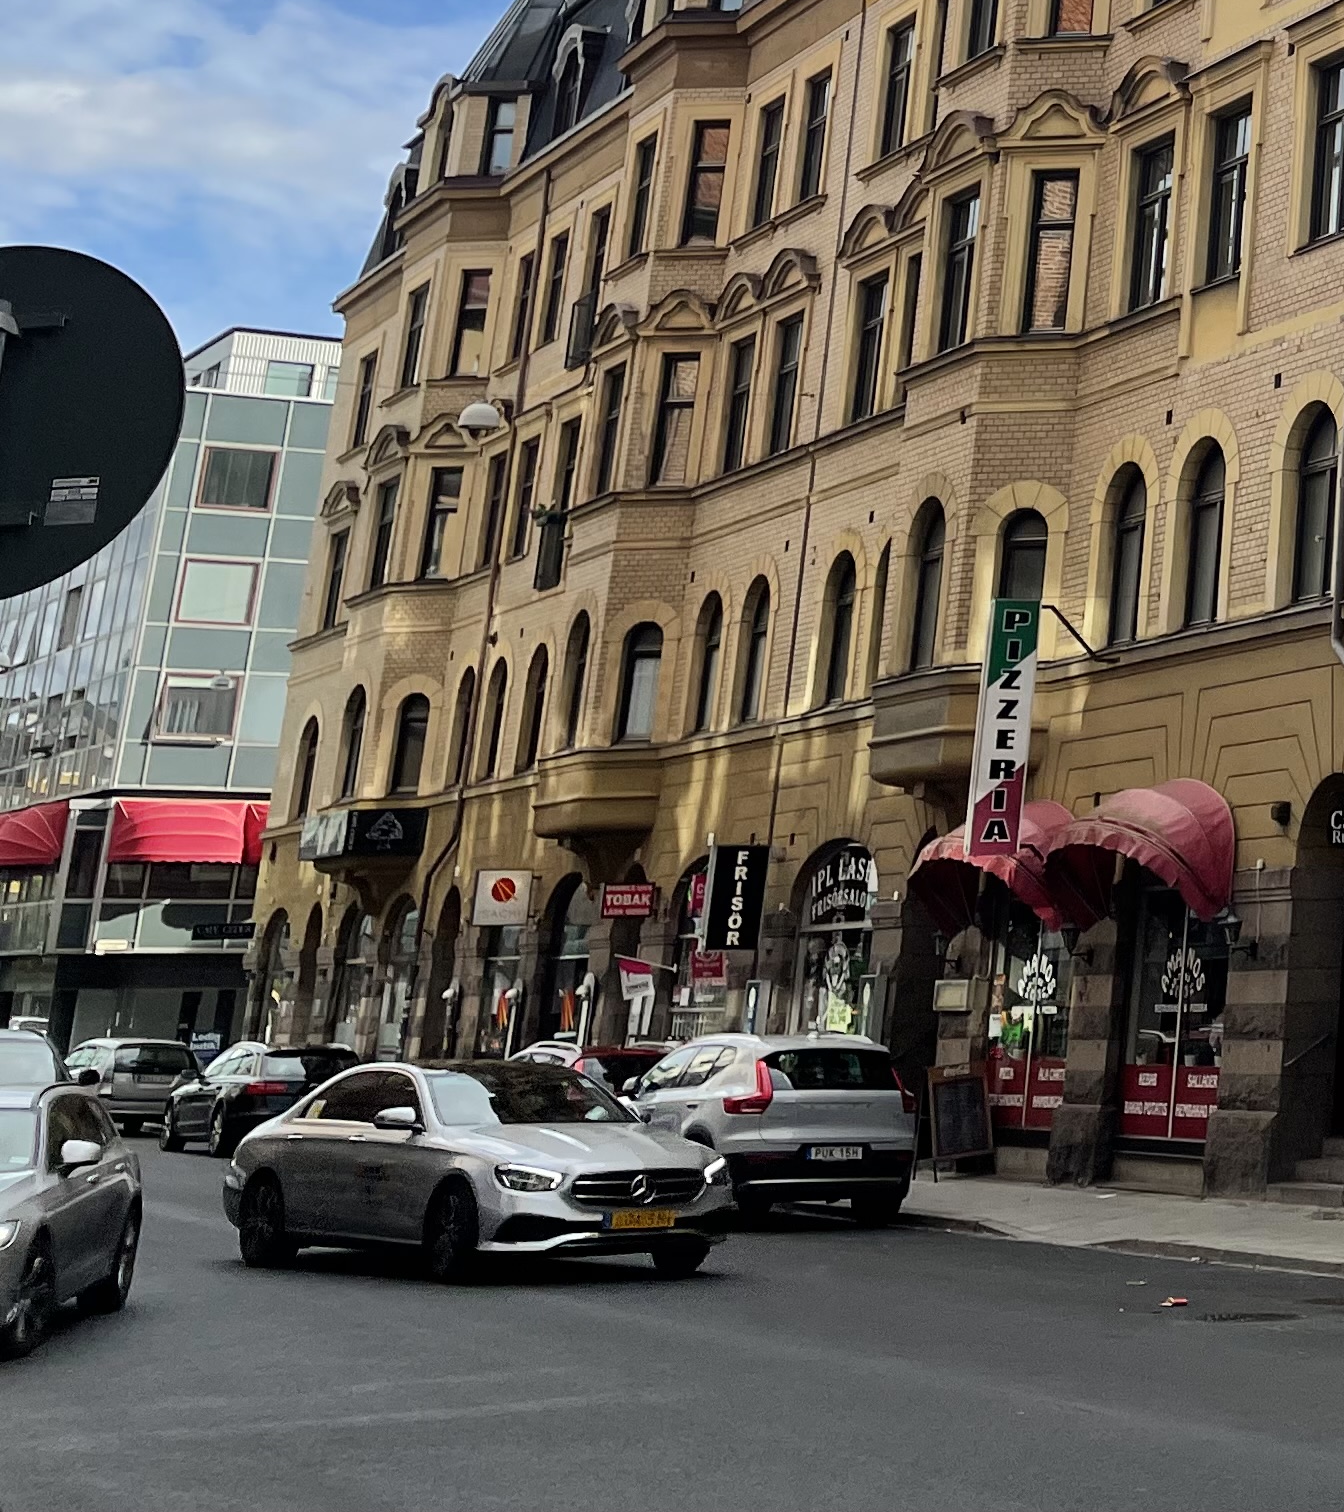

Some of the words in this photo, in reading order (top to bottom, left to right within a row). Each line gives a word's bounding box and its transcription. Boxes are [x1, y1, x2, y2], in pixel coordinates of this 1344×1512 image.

[980, 608, 1031, 843] PIZZERIA
[606, 894, 651, 906] TOBAK
[726, 850, 749, 946] FRISÖR
[812, 865, 833, 897] IPL
